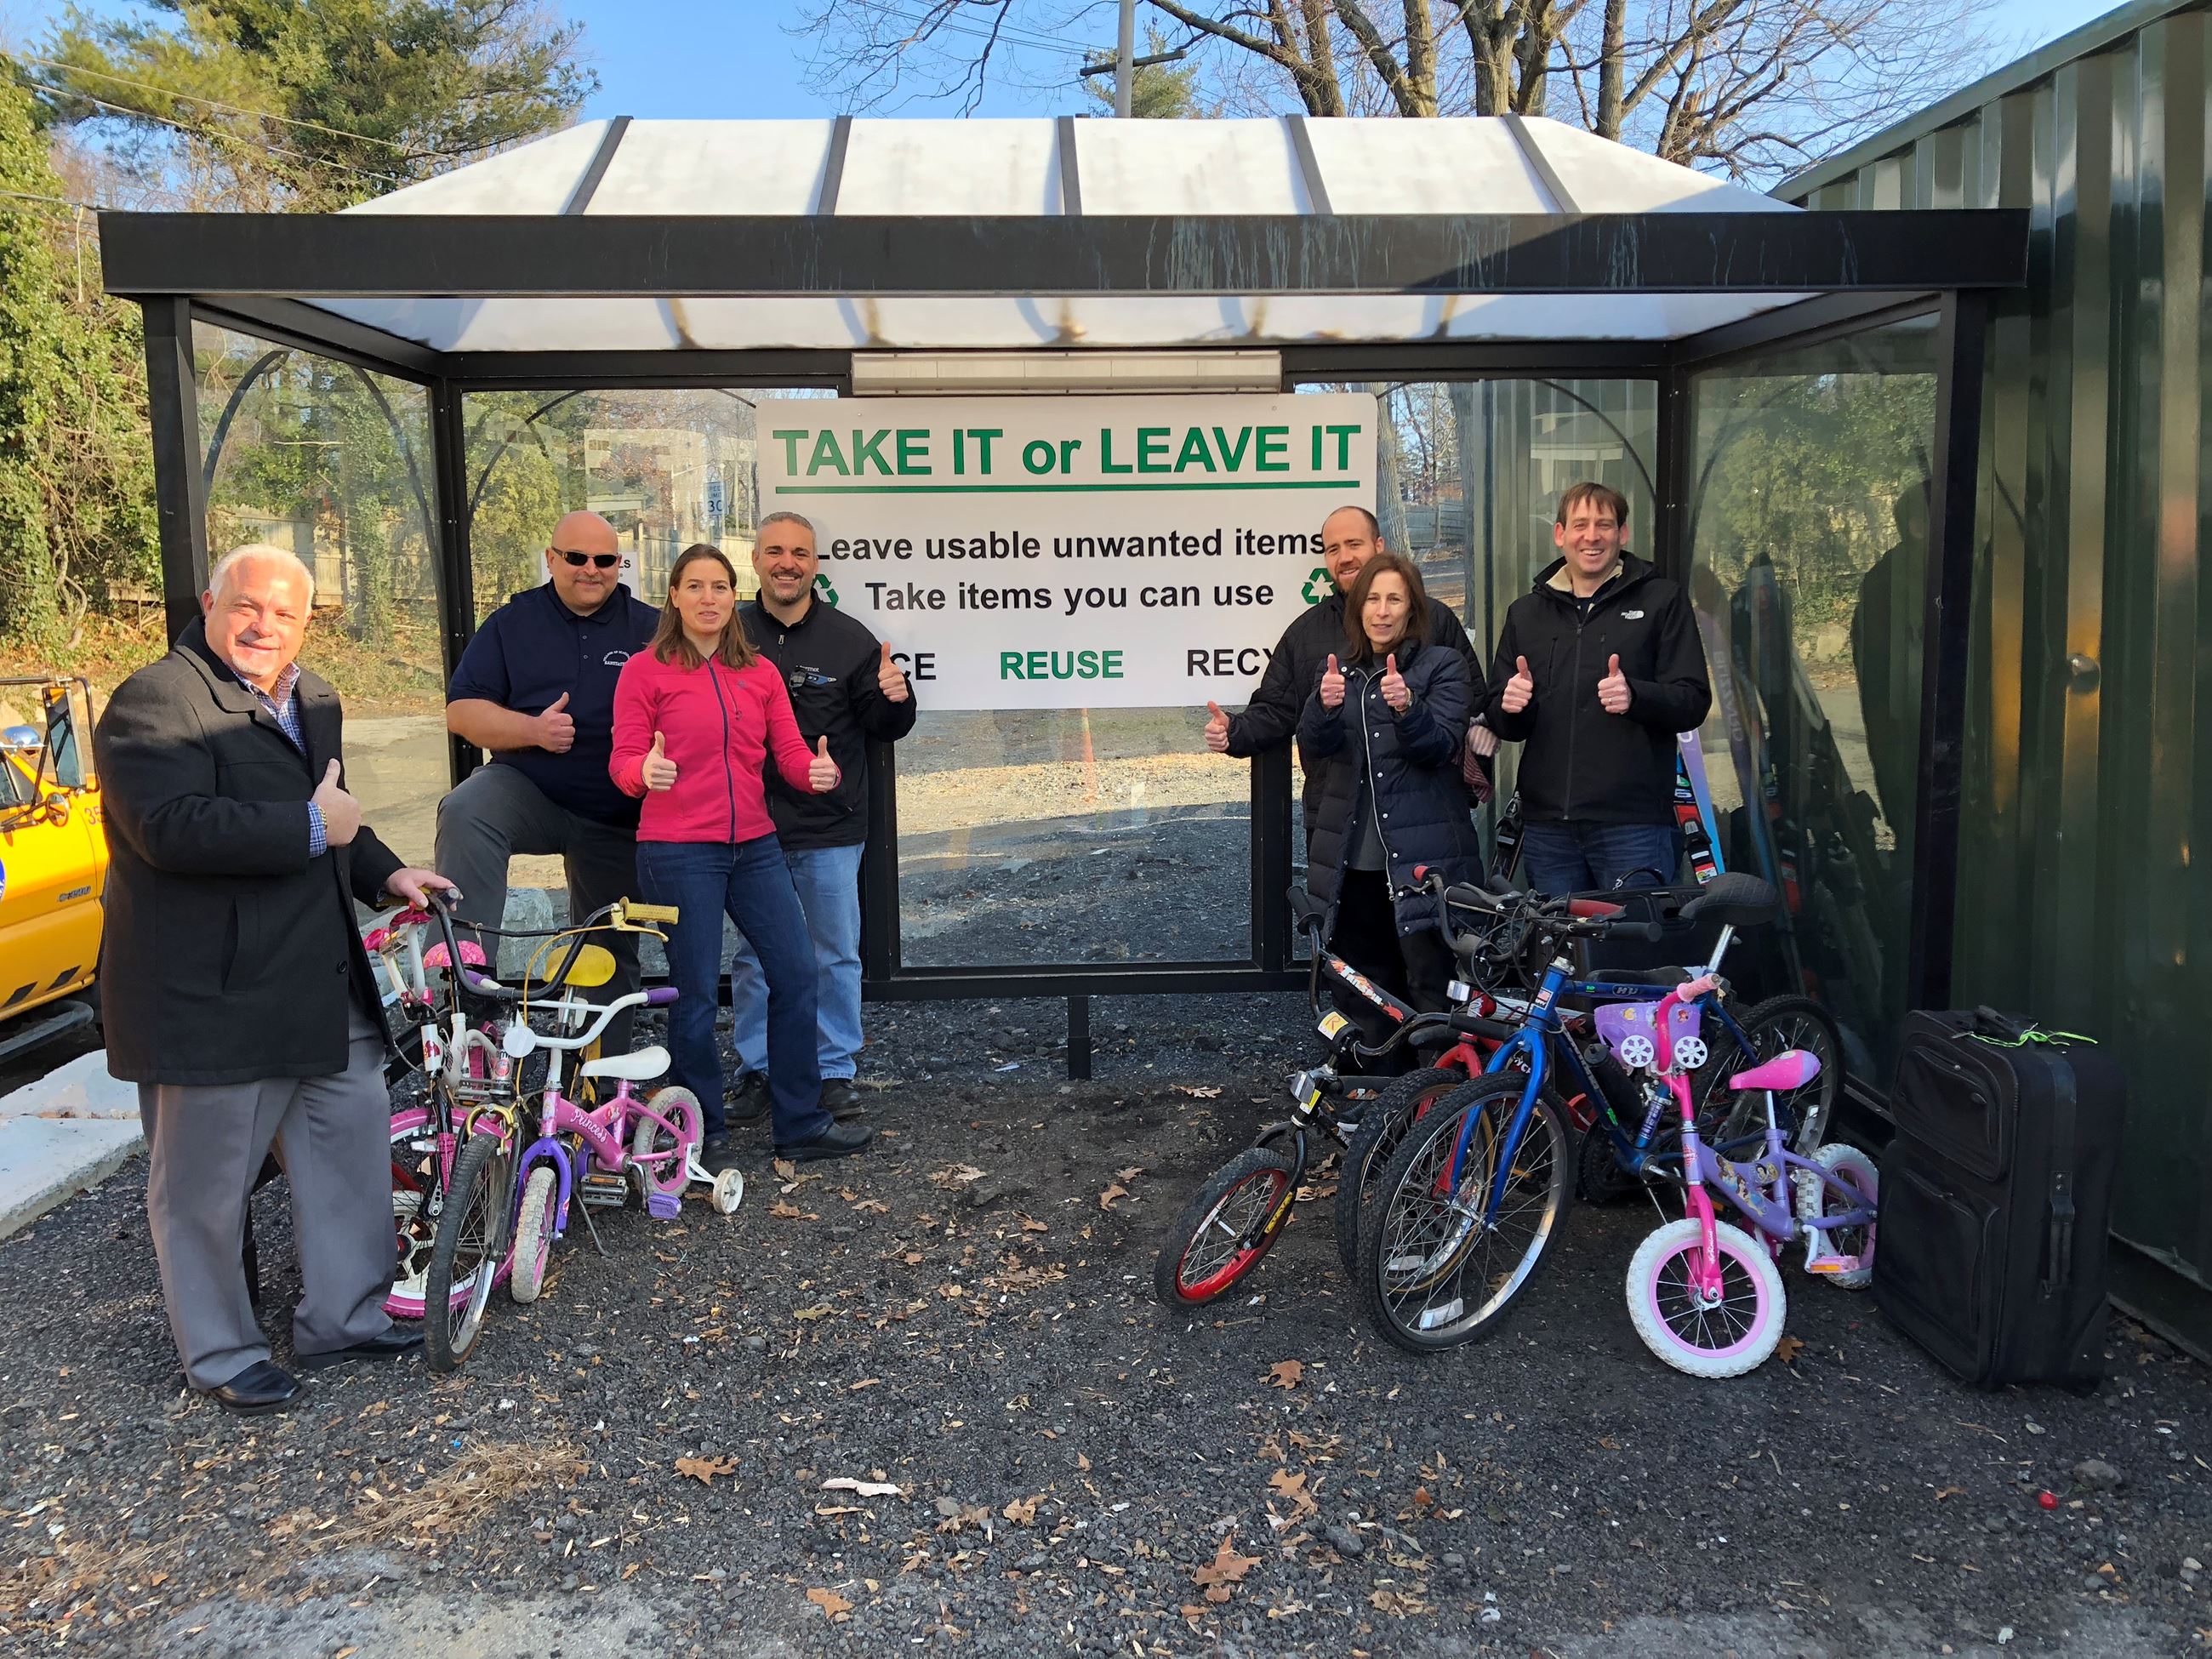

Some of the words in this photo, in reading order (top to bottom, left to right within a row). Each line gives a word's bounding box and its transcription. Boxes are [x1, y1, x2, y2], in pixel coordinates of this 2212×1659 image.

[773, 429, 932, 476] TAKE
[952, 428, 1004, 475] IT
[1022, 439, 1081, 475] or
[1101, 425, 1290, 475] LEAVE
[1311, 425, 1361, 470] IT
[926, 530, 1040, 560] usable
[1053, 528, 1222, 558] unwanted
[1235, 527, 1325, 556] items
[864, 582, 946, 610] Take
[959, 581, 1052, 610] items
[1063, 587, 1126, 616] you
[1140, 585, 1200, 607] can
[1213, 584, 1274, 607] use
[1001, 650, 1124, 680] REUSE
[570, 1108, 607, 1143] Princess
